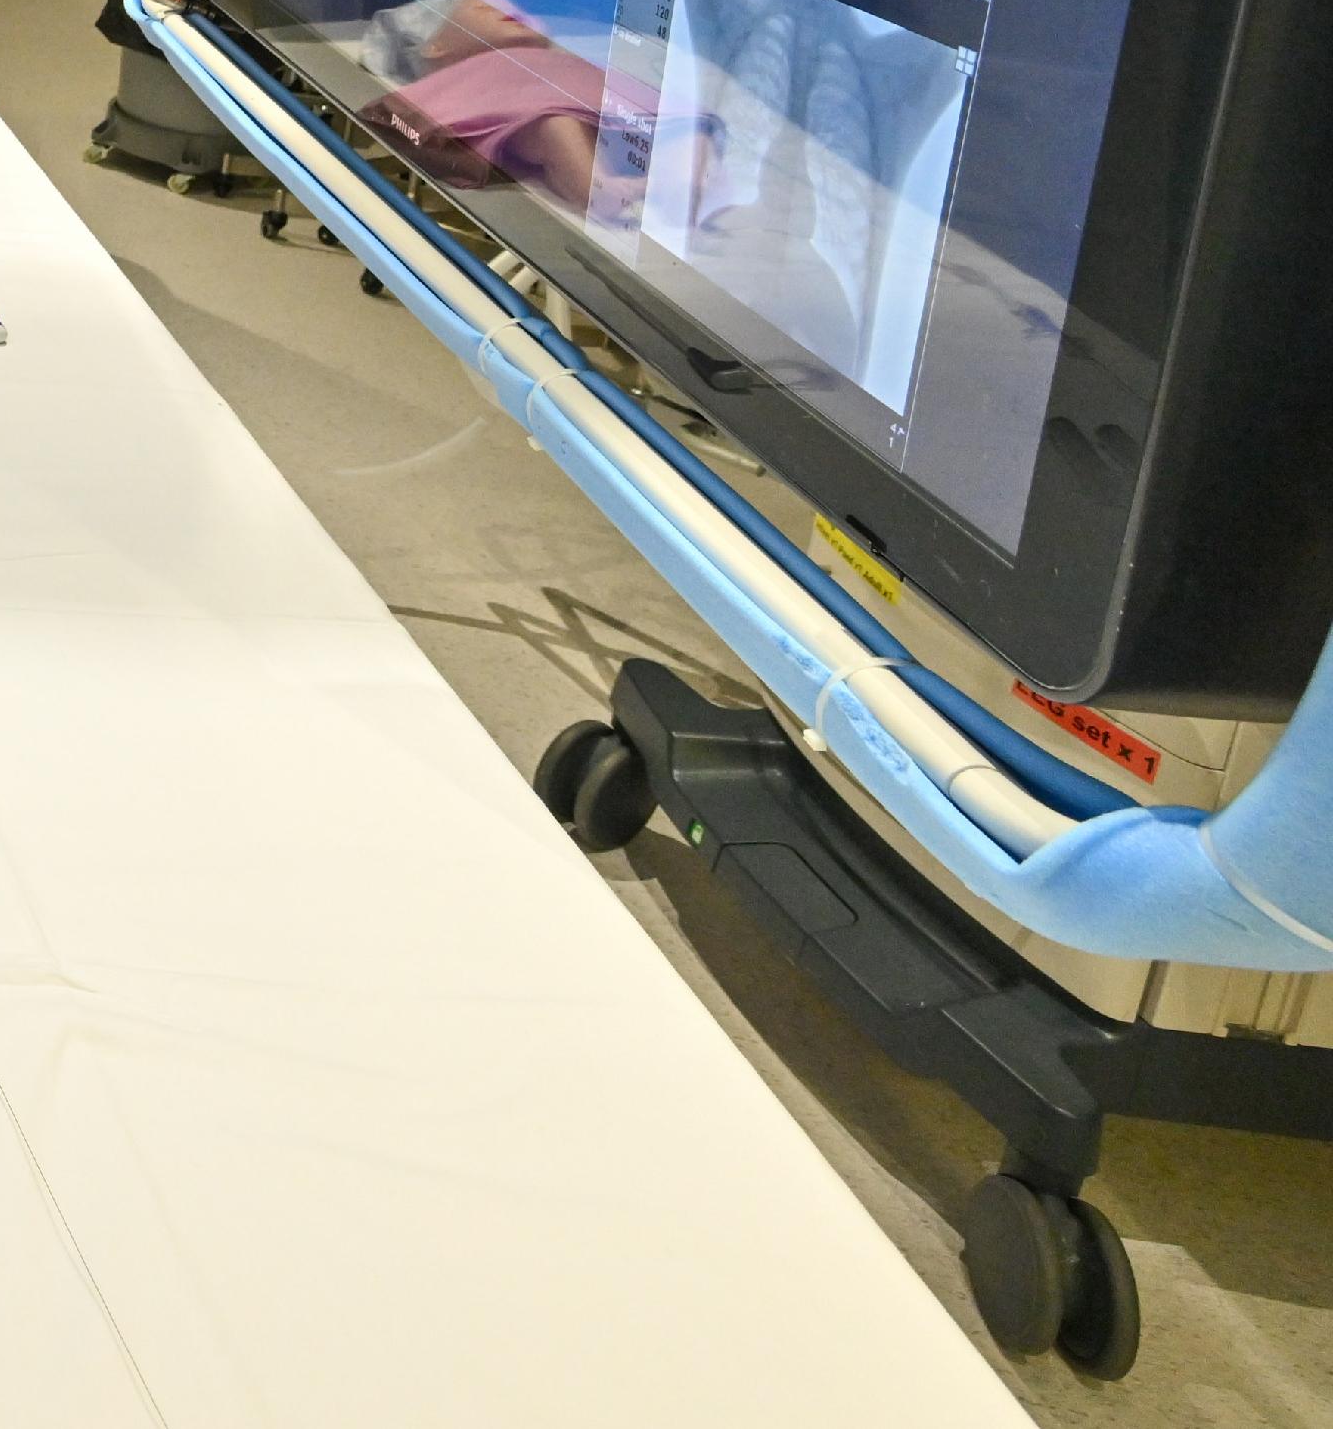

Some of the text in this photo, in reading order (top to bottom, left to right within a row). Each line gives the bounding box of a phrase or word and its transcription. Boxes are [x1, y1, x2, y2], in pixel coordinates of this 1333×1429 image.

[655, 4, 670, 20] 120
[657, 25, 667, 40] 48
[1072, 715, 1111, 749] set
[1144, 756, 1156, 774] 1
